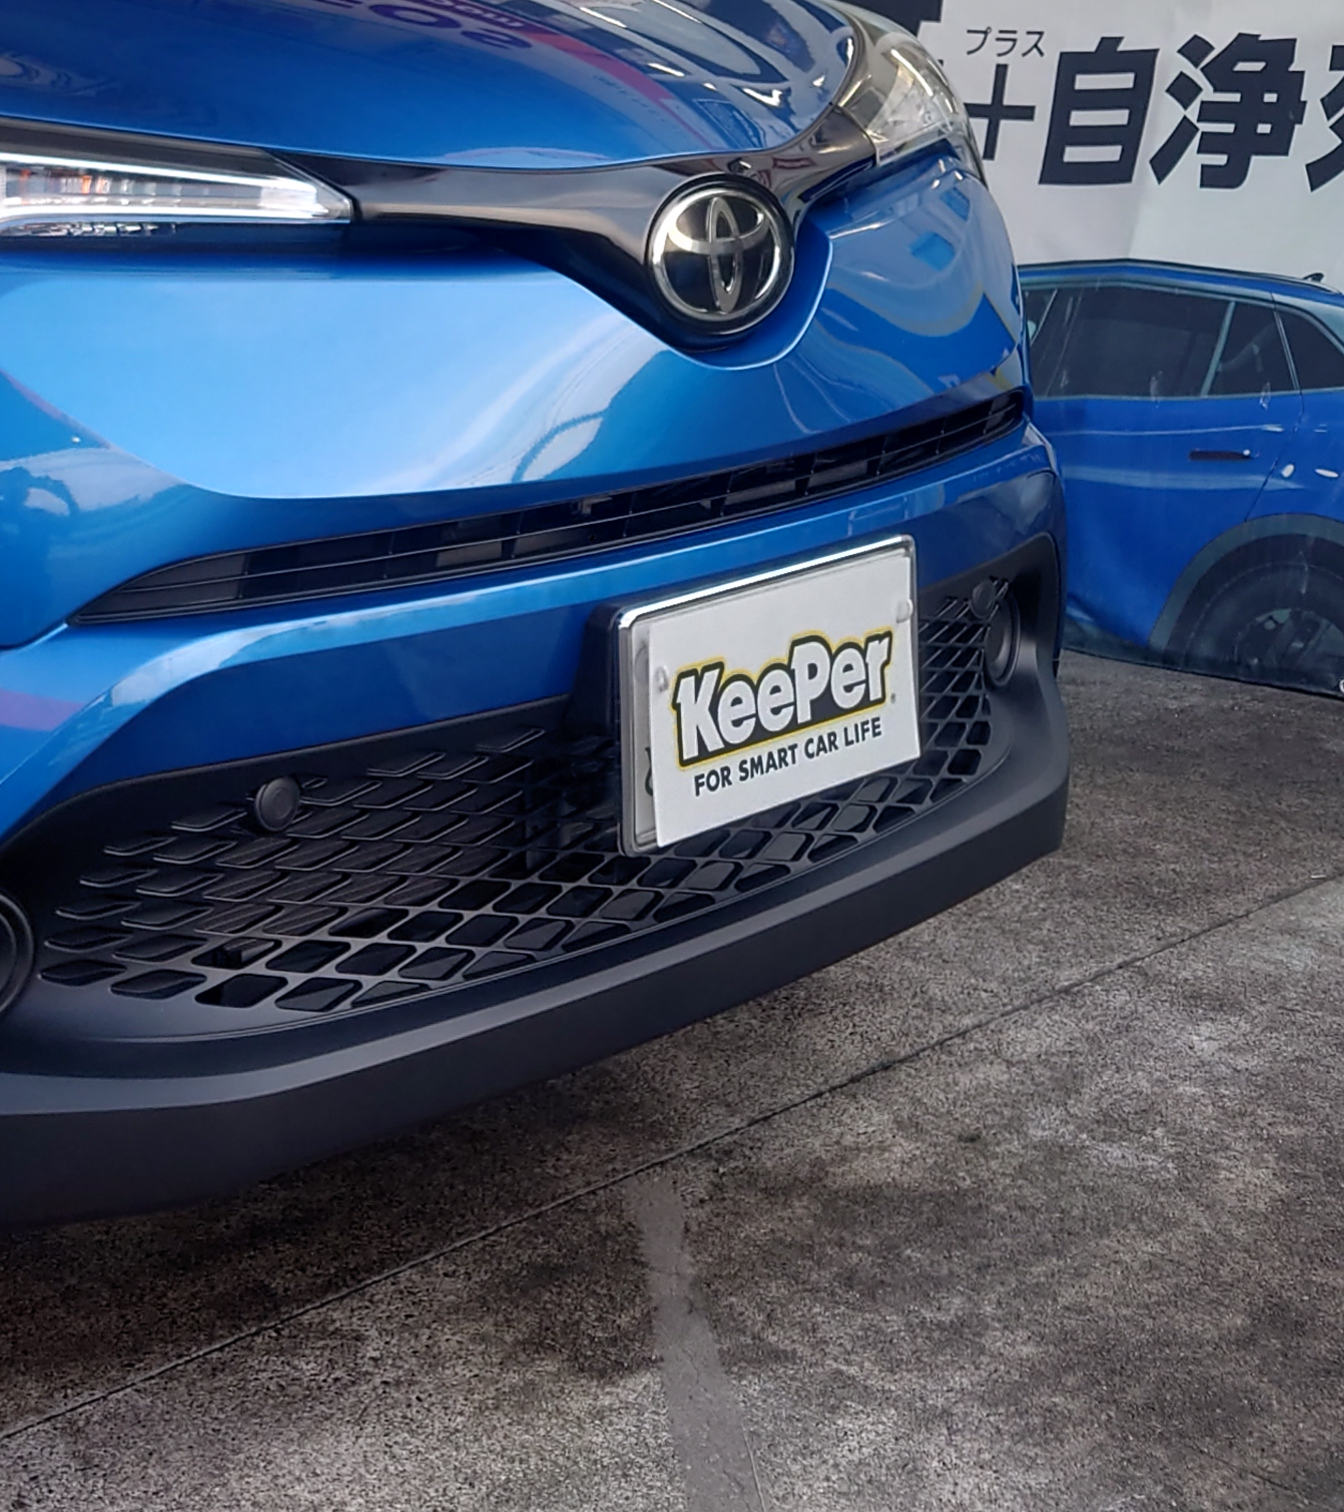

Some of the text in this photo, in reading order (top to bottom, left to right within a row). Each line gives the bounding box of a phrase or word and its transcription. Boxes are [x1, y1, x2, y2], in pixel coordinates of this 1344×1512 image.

[966, 27, 1045, 57] プラス
[672, 629, 894, 769] KeePer
[694, 717, 882, 796] FOR SMART CAR LIFE
